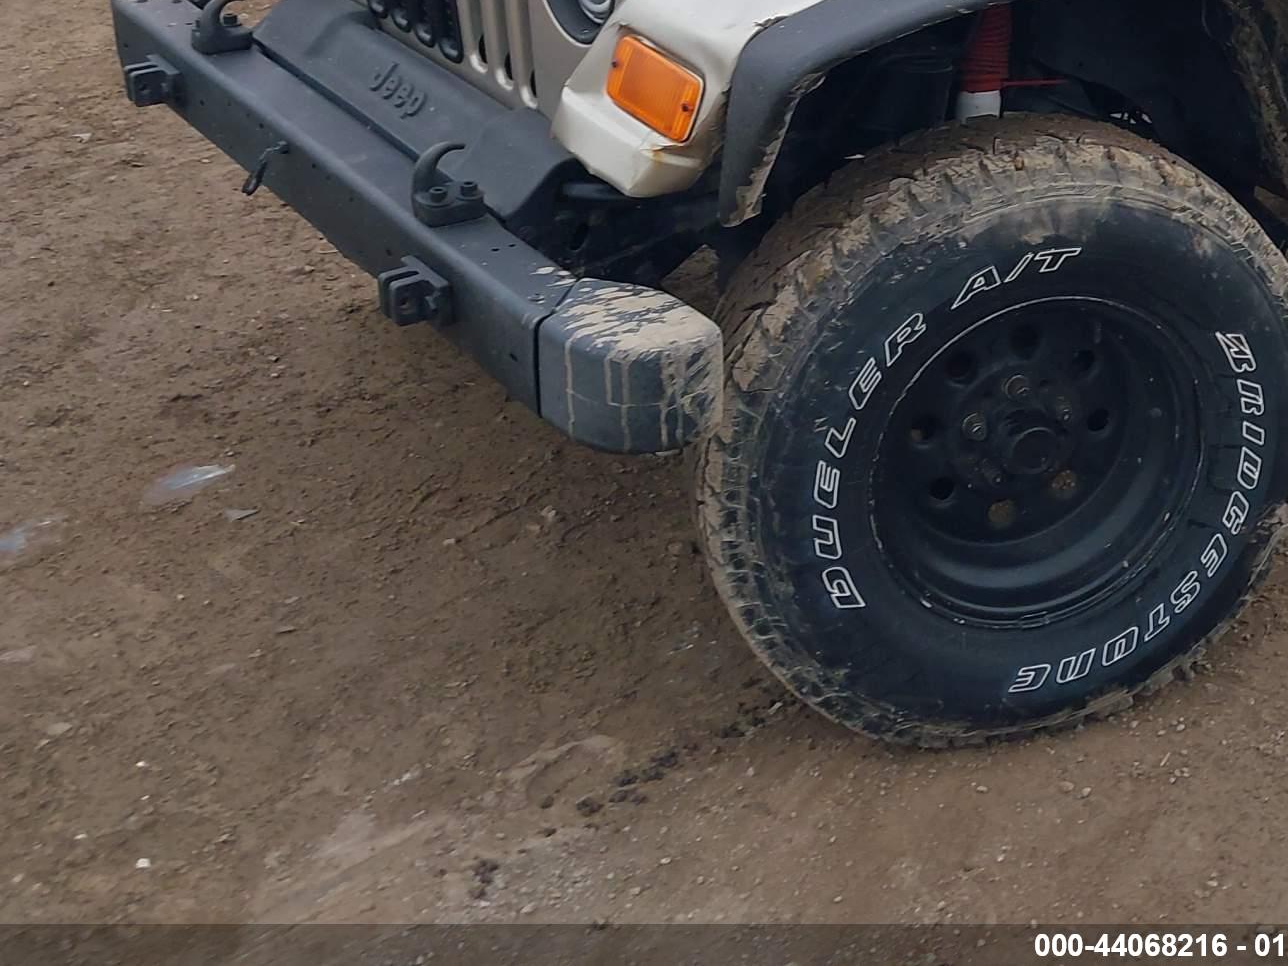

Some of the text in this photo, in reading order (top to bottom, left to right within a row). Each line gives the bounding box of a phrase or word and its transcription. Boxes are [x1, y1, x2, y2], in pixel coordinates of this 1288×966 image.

[369, 61, 428, 120] Jeep
[810, 246, 1083, 611] DUELER A/T
[1008, 330, 1269, 695] BRIDGESTONE
